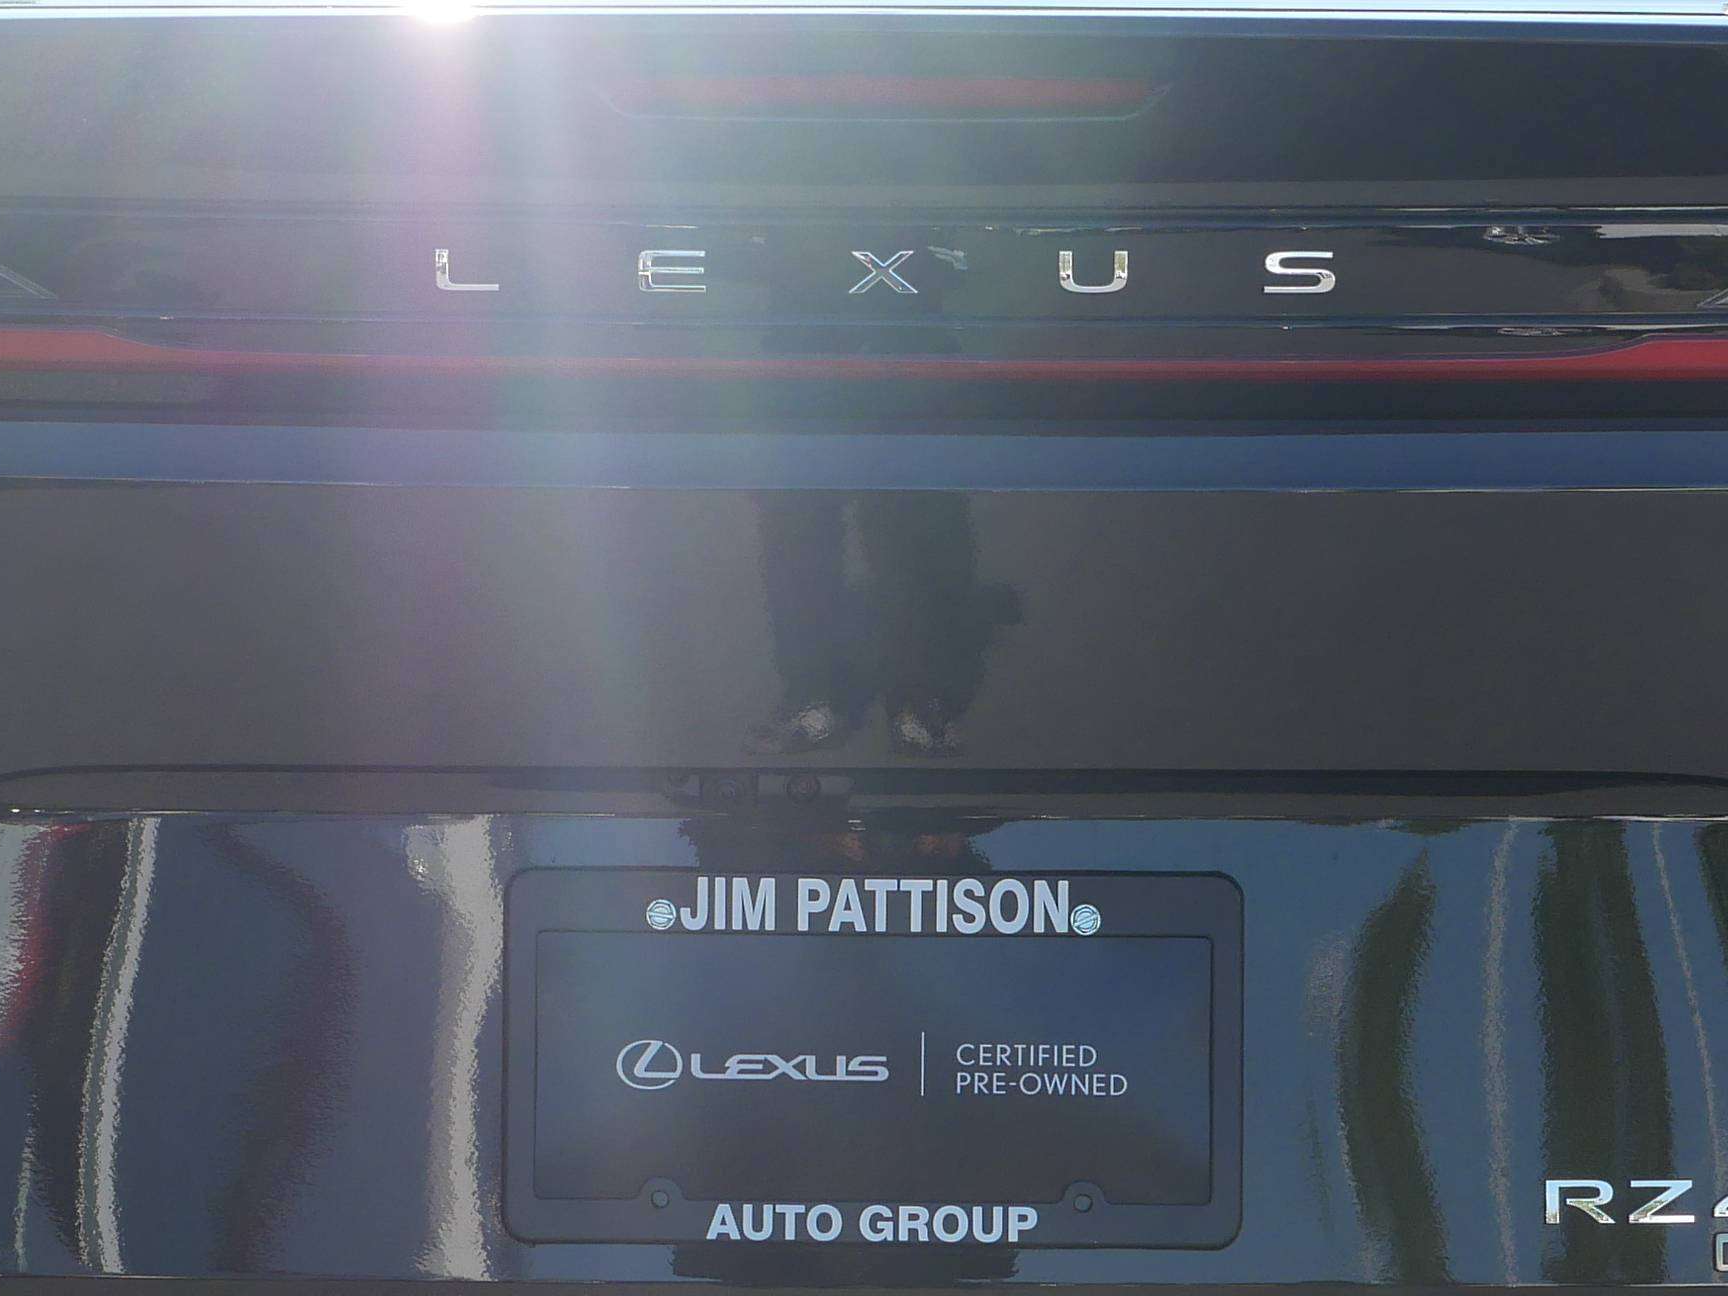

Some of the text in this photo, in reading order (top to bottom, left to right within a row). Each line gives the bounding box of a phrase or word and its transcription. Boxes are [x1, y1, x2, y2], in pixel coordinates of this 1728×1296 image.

[434, 249, 1336, 294] LEXUS
[680, 876, 1070, 935] JIM PATTISON
[690, 1053, 889, 1082] LEXUS
[956, 1043, 1097, 1067] CERTIFIED
[956, 1072, 1128, 1096] PRE-OWNED
[1544, 1178, 1696, 1225] RZ
[705, 1203, 1039, 1243] AUTO GROUP
